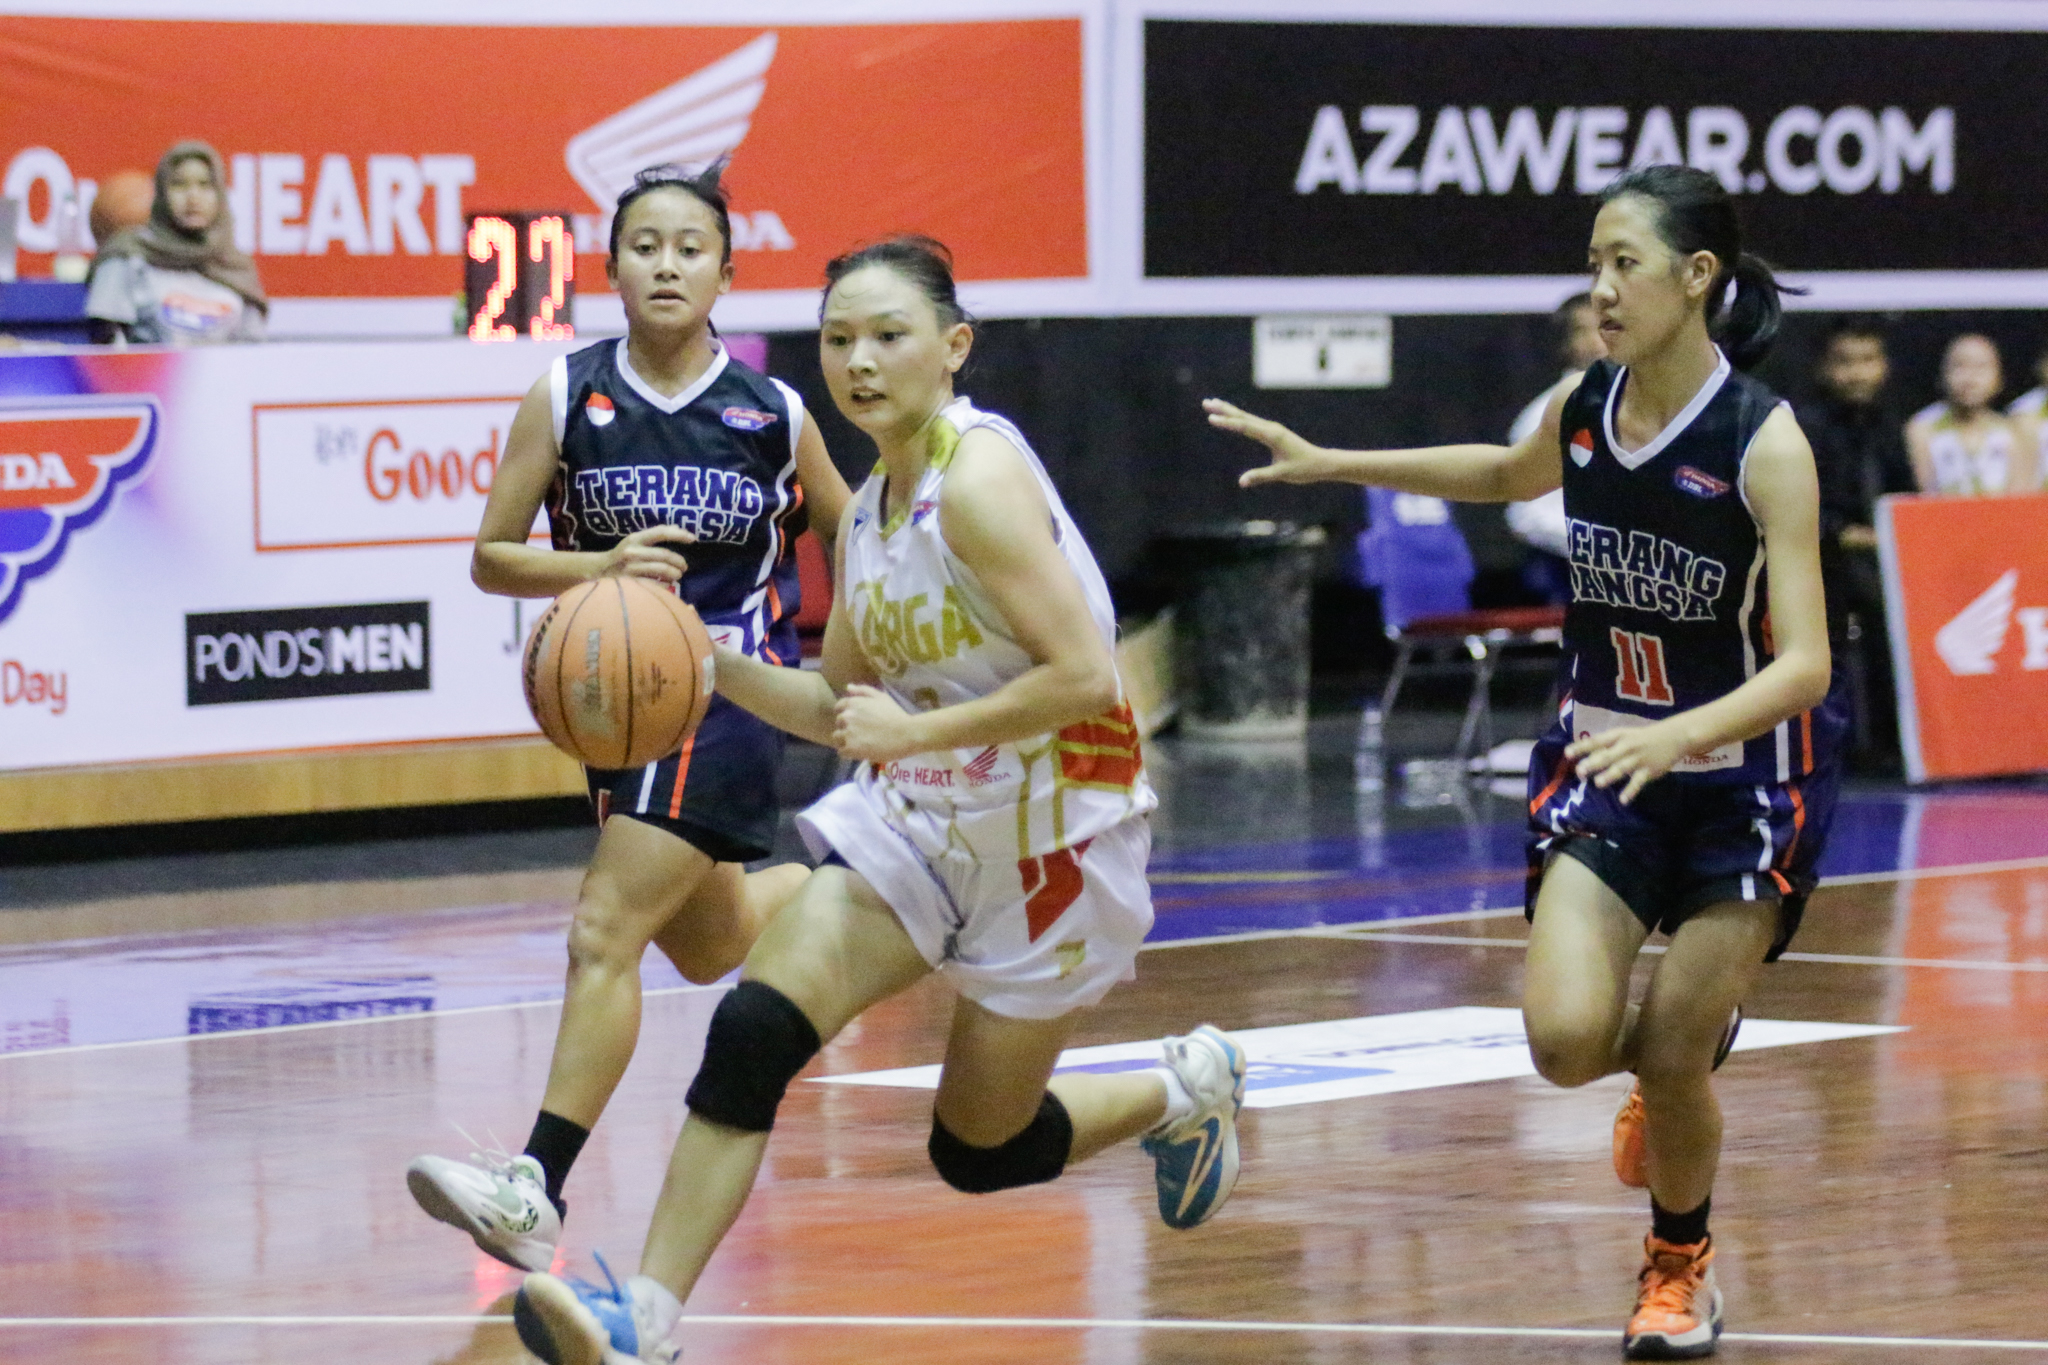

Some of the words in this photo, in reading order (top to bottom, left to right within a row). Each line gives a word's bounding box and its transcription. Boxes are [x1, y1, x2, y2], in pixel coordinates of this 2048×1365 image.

[1294, 105, 1956, 195] AZAWEAR.COM
[364, 427, 500, 503] Good
[575, 465, 764, 519] TERANG
[1566, 516, 1727, 601] ERANG
[1569, 562, 1717, 622] ANGSA
[330, 621, 423, 675] MEN
[1610, 626, 1675, 707] 11
[1, 659, 68, 715] Day
